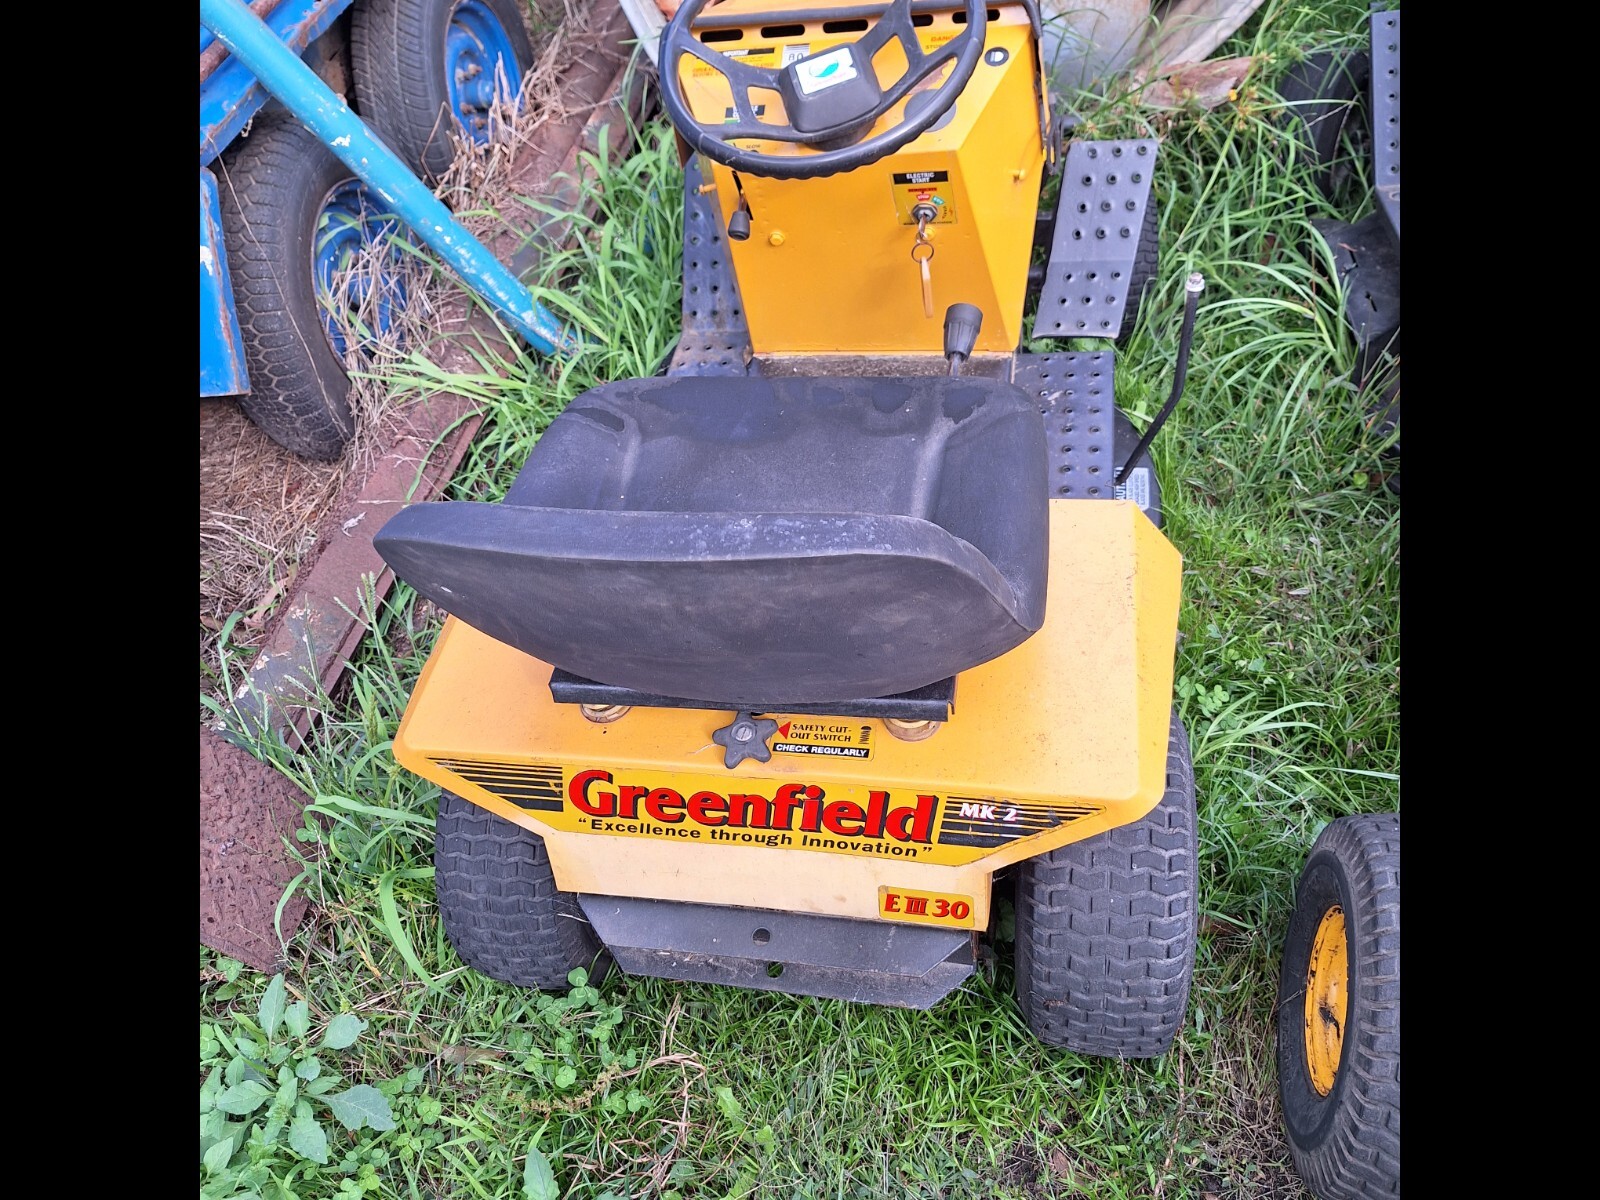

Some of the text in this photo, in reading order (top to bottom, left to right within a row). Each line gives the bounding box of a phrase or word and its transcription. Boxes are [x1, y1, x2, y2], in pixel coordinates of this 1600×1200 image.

[792, 723, 826, 732] SAFETY
[790, 732, 852, 742] OUT SWITCH
[776, 743, 867, 757] CHECK REGULARLY
[568, 769, 940, 844] Greenfield
[959, 802, 1018, 823] MK 2
[710, 829, 793, 847] through
[884, 893, 970, 920] E III 30
